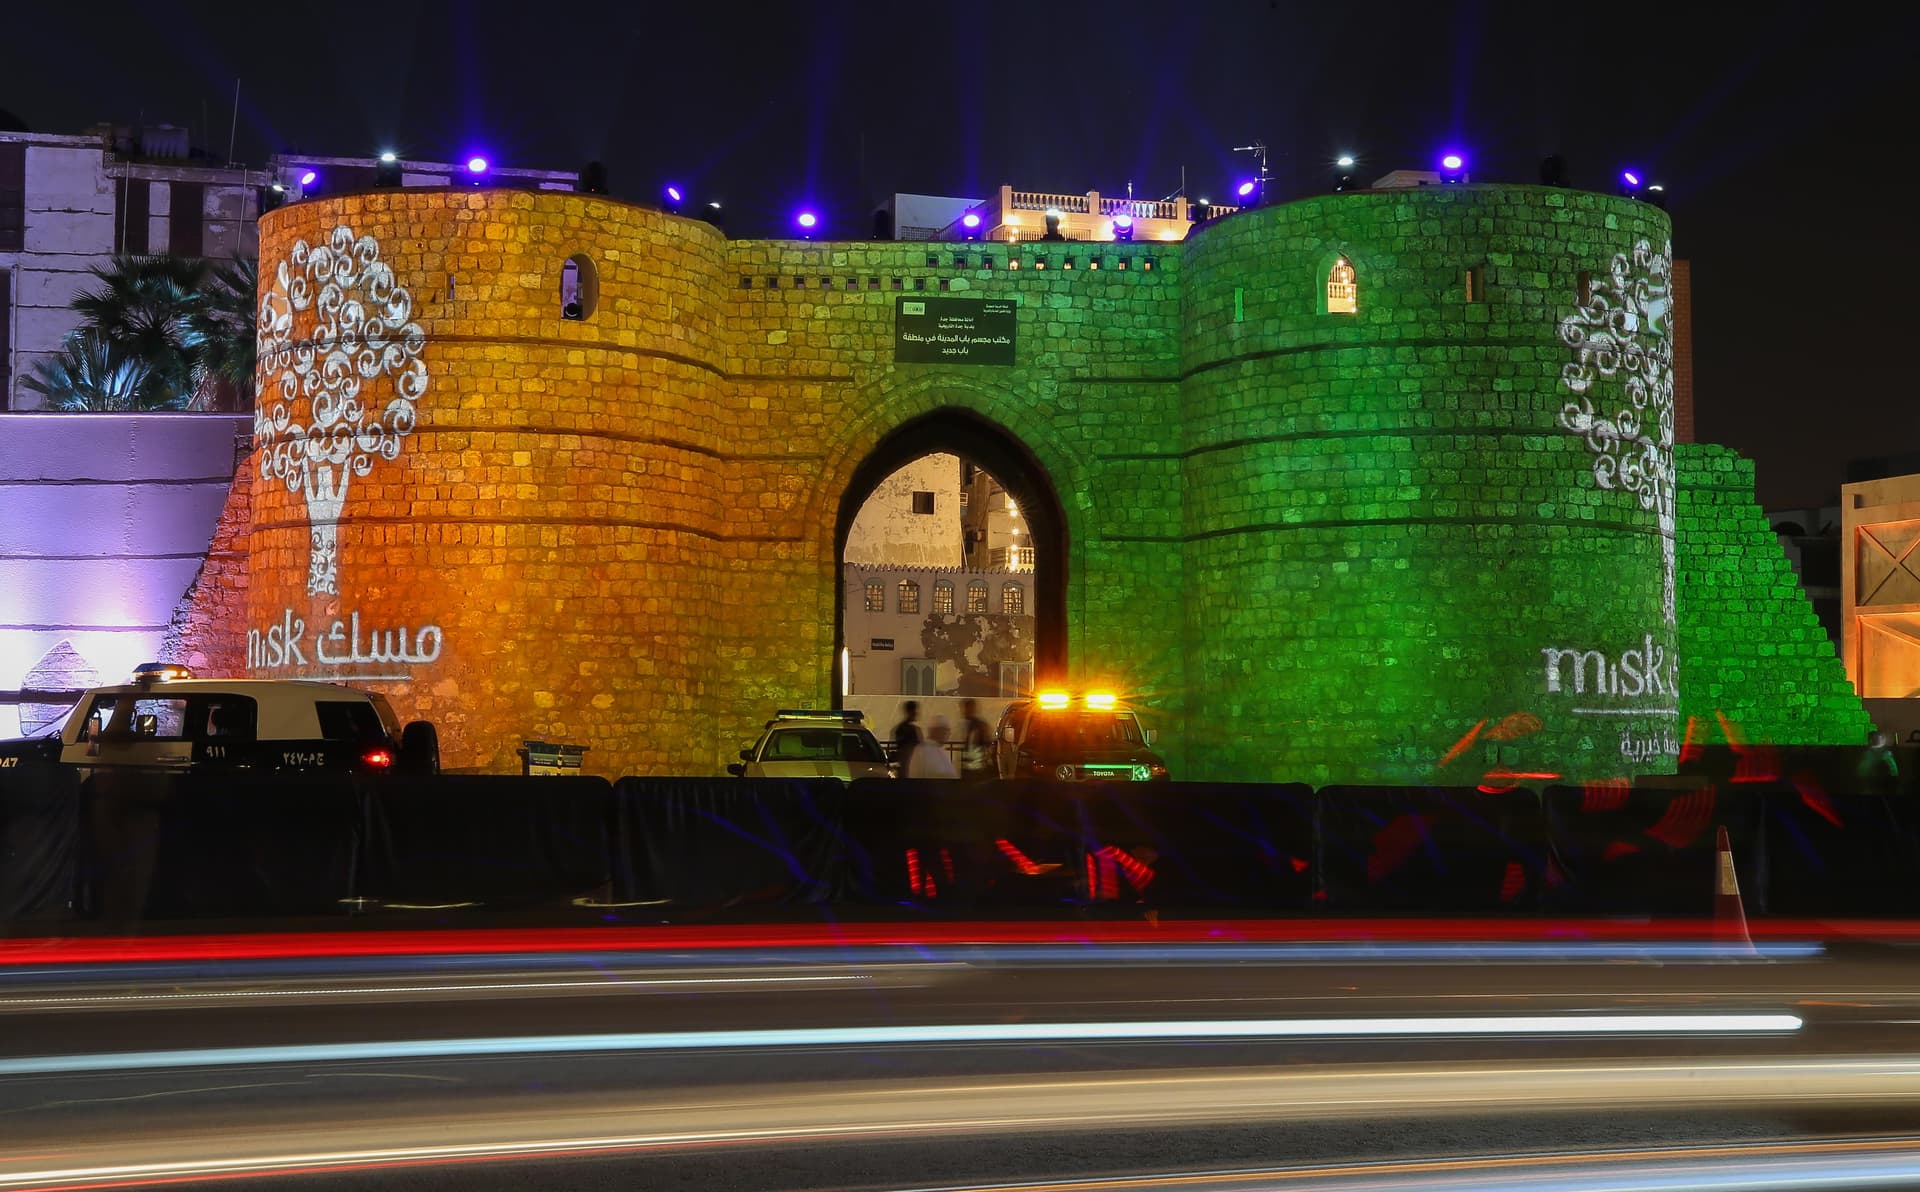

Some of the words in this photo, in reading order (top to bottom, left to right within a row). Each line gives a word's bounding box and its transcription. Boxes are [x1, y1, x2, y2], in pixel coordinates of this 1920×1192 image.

[902, 332, 924, 342] منطقة
[925, 335, 936, 345] في
[937, 333, 959, 343] المدينة
[959, 334, 970, 343] باب
[957, 346, 969, 355] باب
[317, 610, 441, 665] مسك
[1541, 634, 1667, 697] misk
[0, 757, 19, 768] 47
